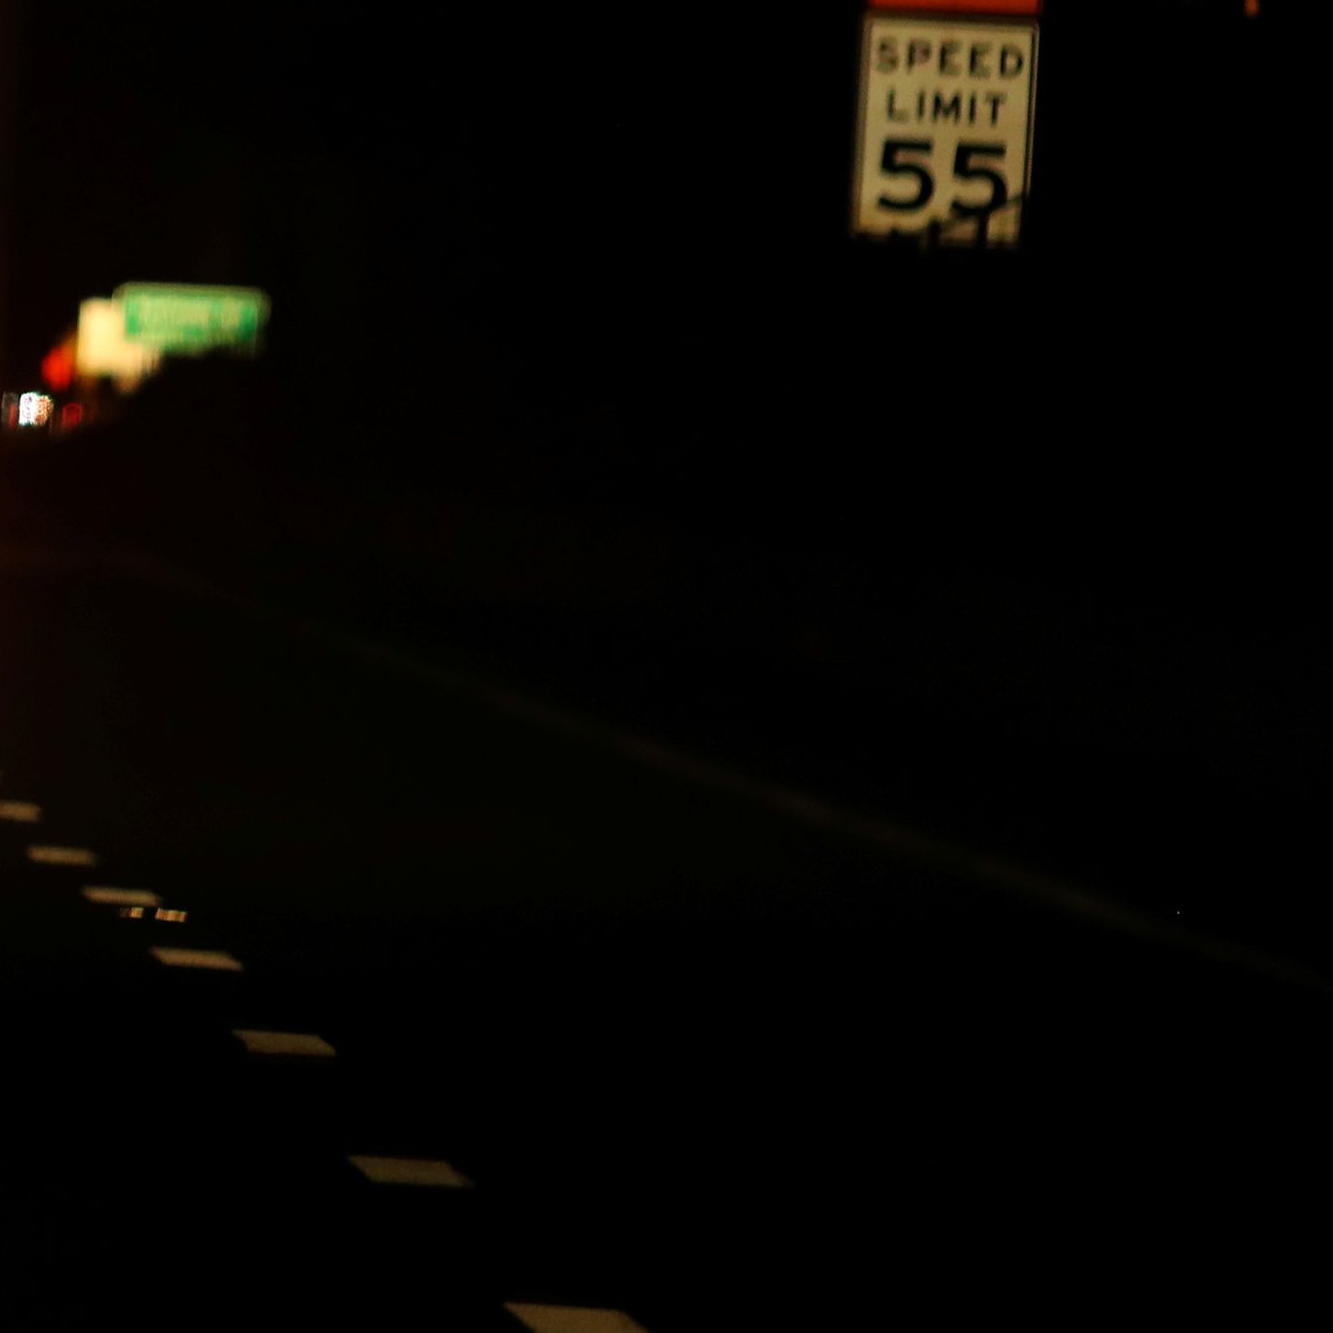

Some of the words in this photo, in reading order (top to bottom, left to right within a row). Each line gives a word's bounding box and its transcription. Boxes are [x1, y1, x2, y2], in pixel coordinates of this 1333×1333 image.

[876, 36, 1025, 79] SPEED
[887, 88, 1006, 127] LIMIT
[876, 136, 1009, 216] 55
